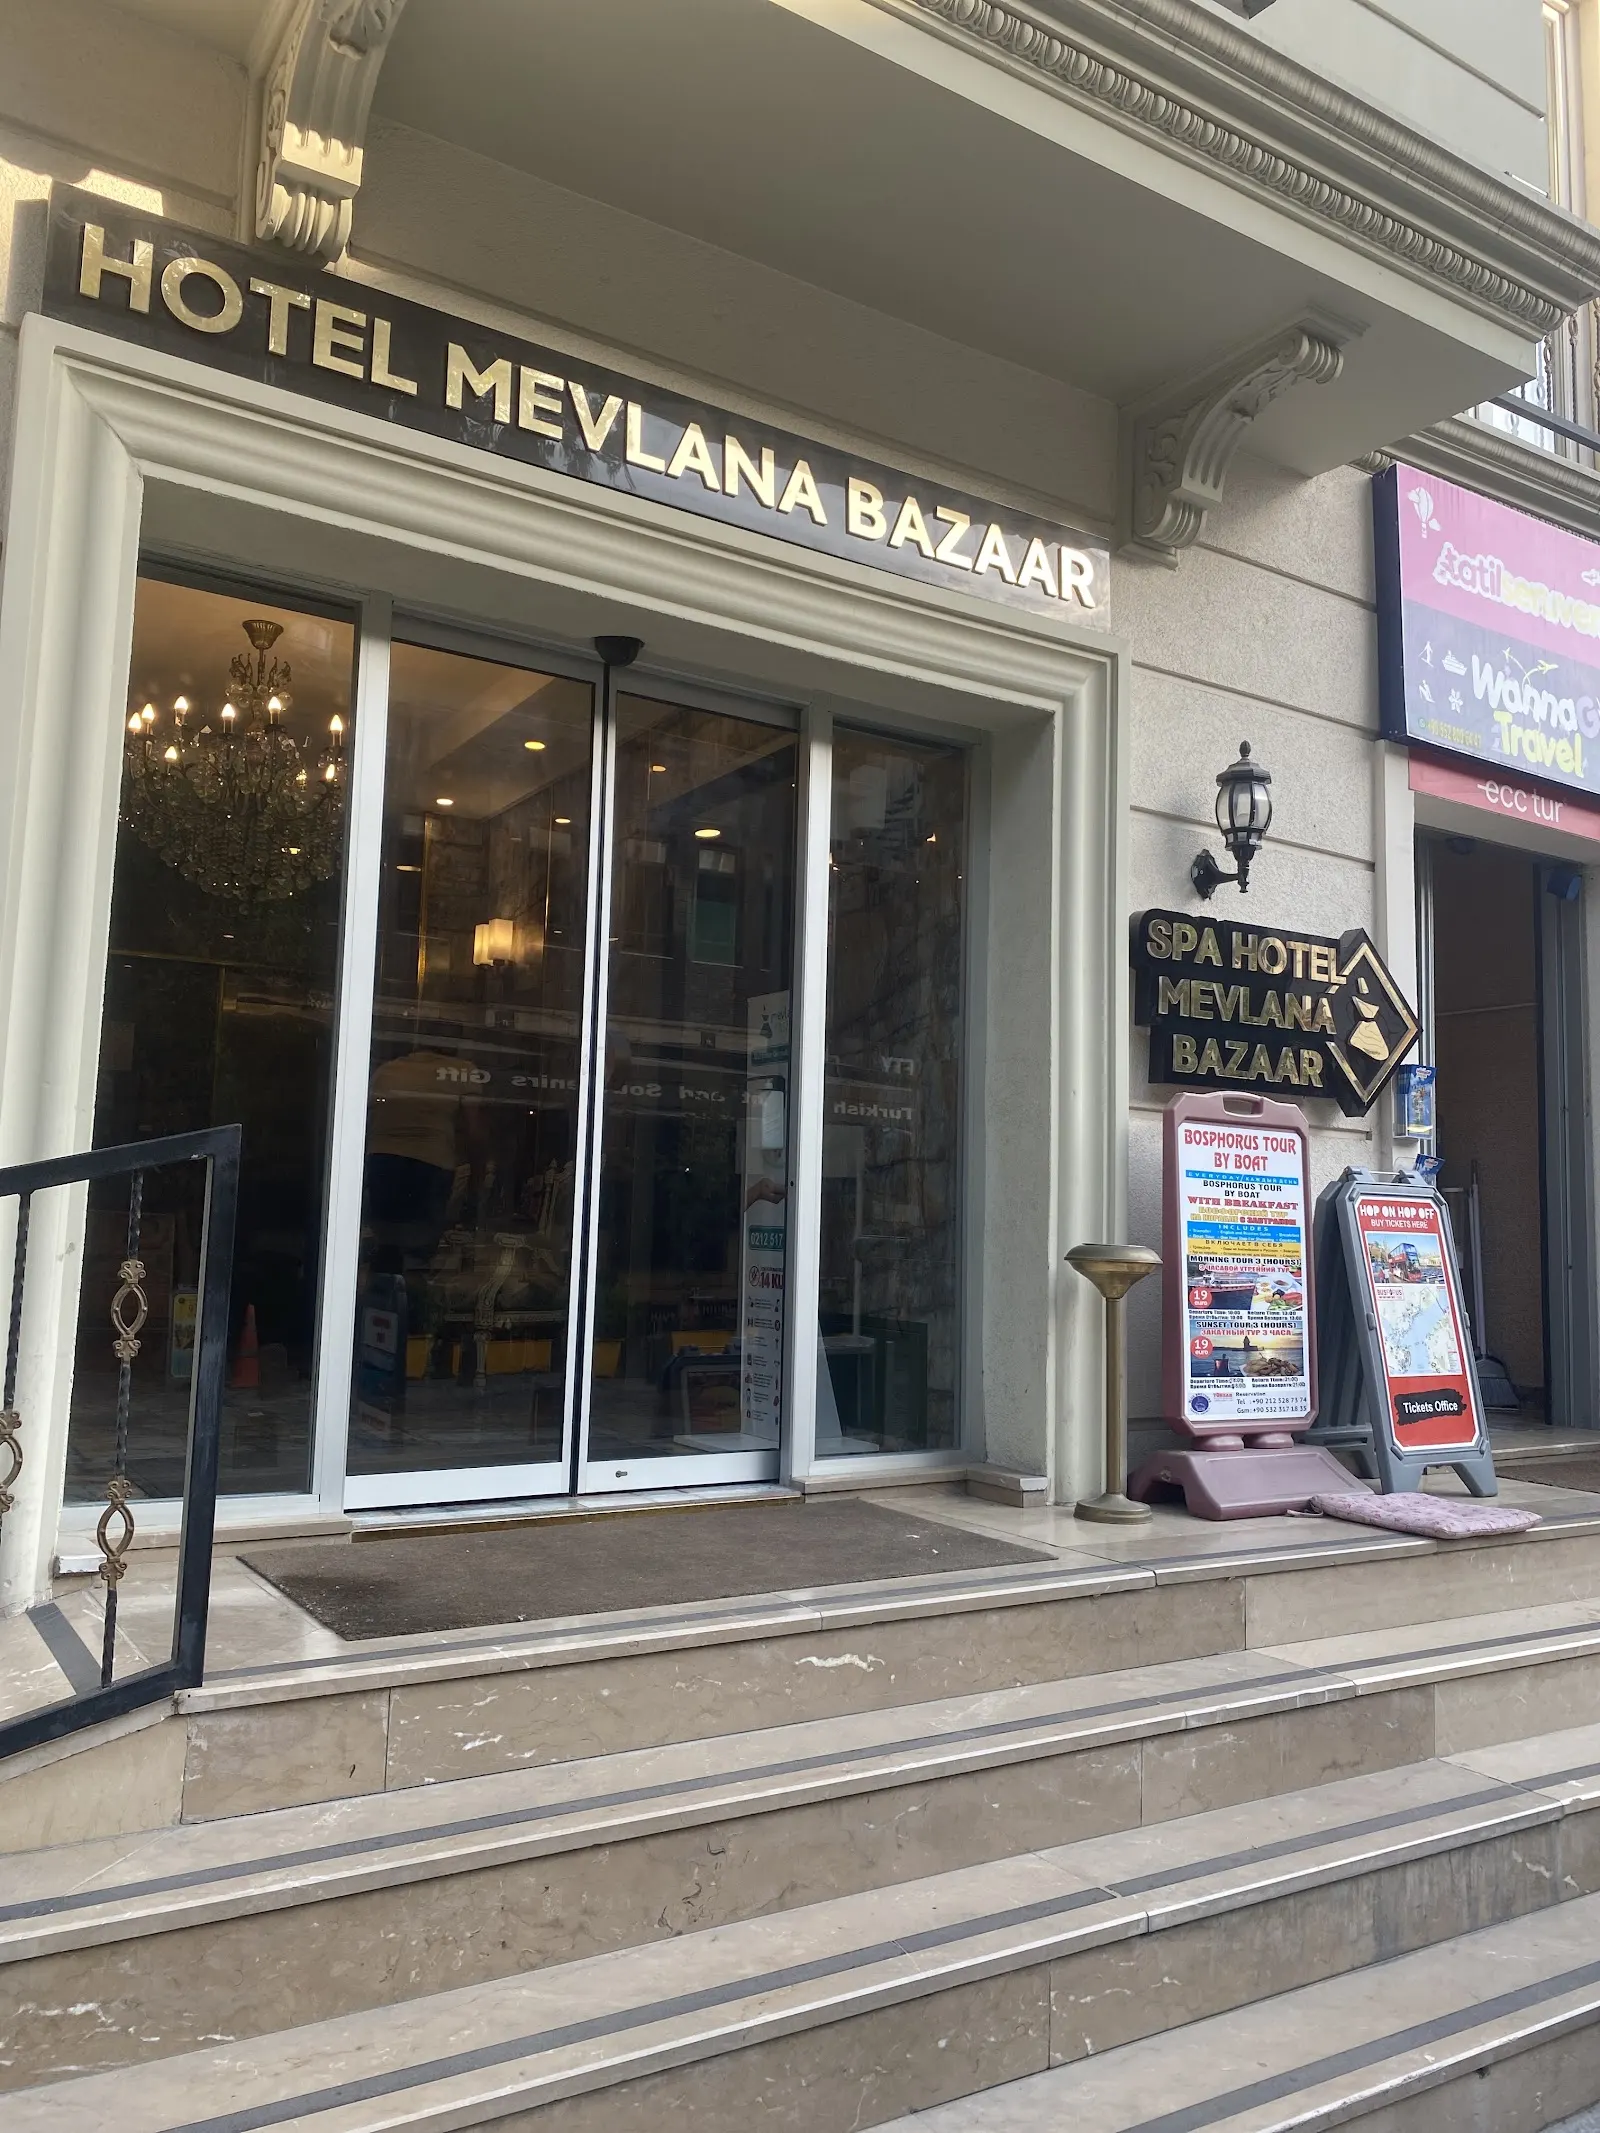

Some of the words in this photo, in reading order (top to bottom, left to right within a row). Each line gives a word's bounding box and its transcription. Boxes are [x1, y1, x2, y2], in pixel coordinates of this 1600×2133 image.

[78, 222, 418, 396] HOTEL
[445, 341, 828, 526] MEVLANA
[846, 476, 1096, 608] BAZAAR
[1493, 711, 1584, 778] Travel
[1531, 789, 1563, 822] tur
[1147, 919, 1223, 966] SPA
[1231, 931, 1346, 984] HOTEL
[1158, 975, 1337, 1034] MEVLANA
[1172, 1034, 1323, 1088] BAZAAR
[1184, 1129, 1259, 1150] BOSPHORUS
[1263, 1136, 1296, 1155] TOUR
[1214, 1152, 1229, 1169] BY
[1234, 1154, 1268, 1171] BOAT
[1203, 1180, 1256, 1190] BOSPHORUS
[1259, 1184, 1282, 1192] TOUR
[1238, 1191, 1260, 1199] BOAT
[1187, 1196, 1221, 1206] WITH
[1224, 1198, 1298, 1210] BREAKFAST
[1360, 1204, 1380, 1217] HOP
[1381, 1205, 1396, 1217] ON
[1397, 1206, 1417, 1219] HOP
[1418, 1207, 1435, 1220] OFF
[1218, 1224, 1269, 1232] INCLUDES
[1371, 1219, 1385, 1227] BUY
[1385, 1219, 1411, 1228] TICKETS
[1412, 1220, 1429, 1229] HERE
[751, 1232, 768, 1246] 0212
[1190, 1255, 1229, 1263] MORNING
[1193, 1290, 1208, 1298] 19
[1194, 1339, 1209, 1350] 19
[1402, 1402, 1434, 1414] Tickets
[1434, 1400, 1458, 1412] Office
